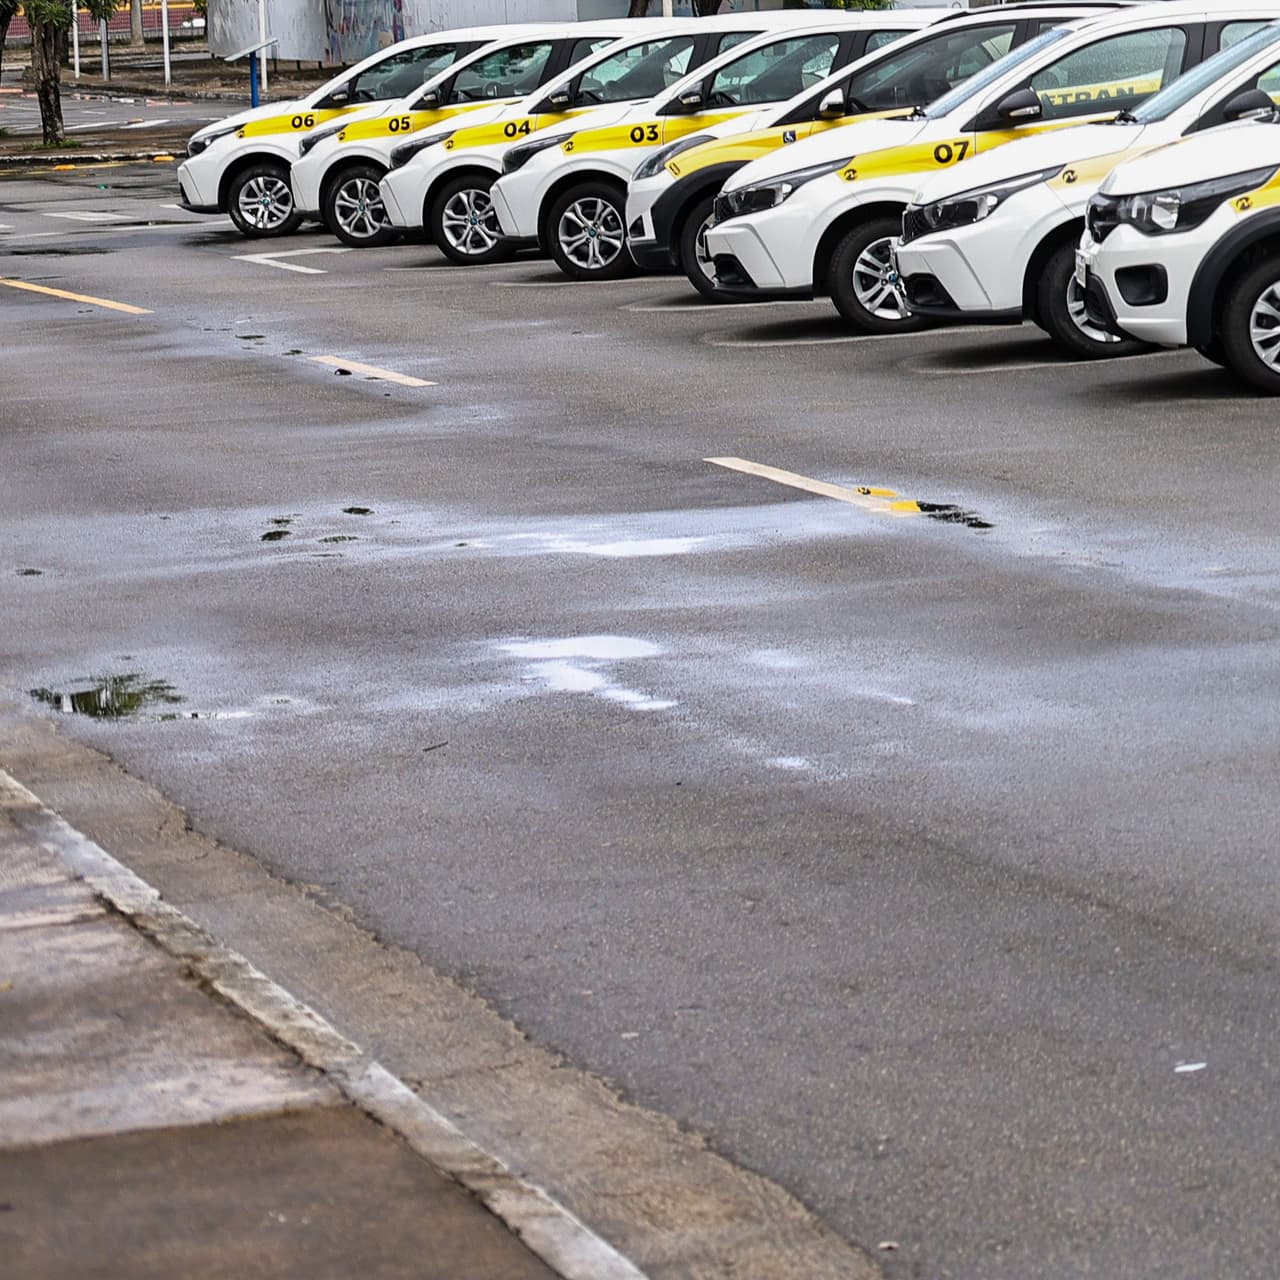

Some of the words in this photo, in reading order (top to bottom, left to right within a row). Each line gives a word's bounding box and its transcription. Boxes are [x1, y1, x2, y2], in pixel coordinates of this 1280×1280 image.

[291, 114, 314, 129] 06
[388, 116, 411, 132] 05
[503, 120, 531, 138] 04
[630, 124, 659, 143] 03
[934, 141, 970, 164] 07
